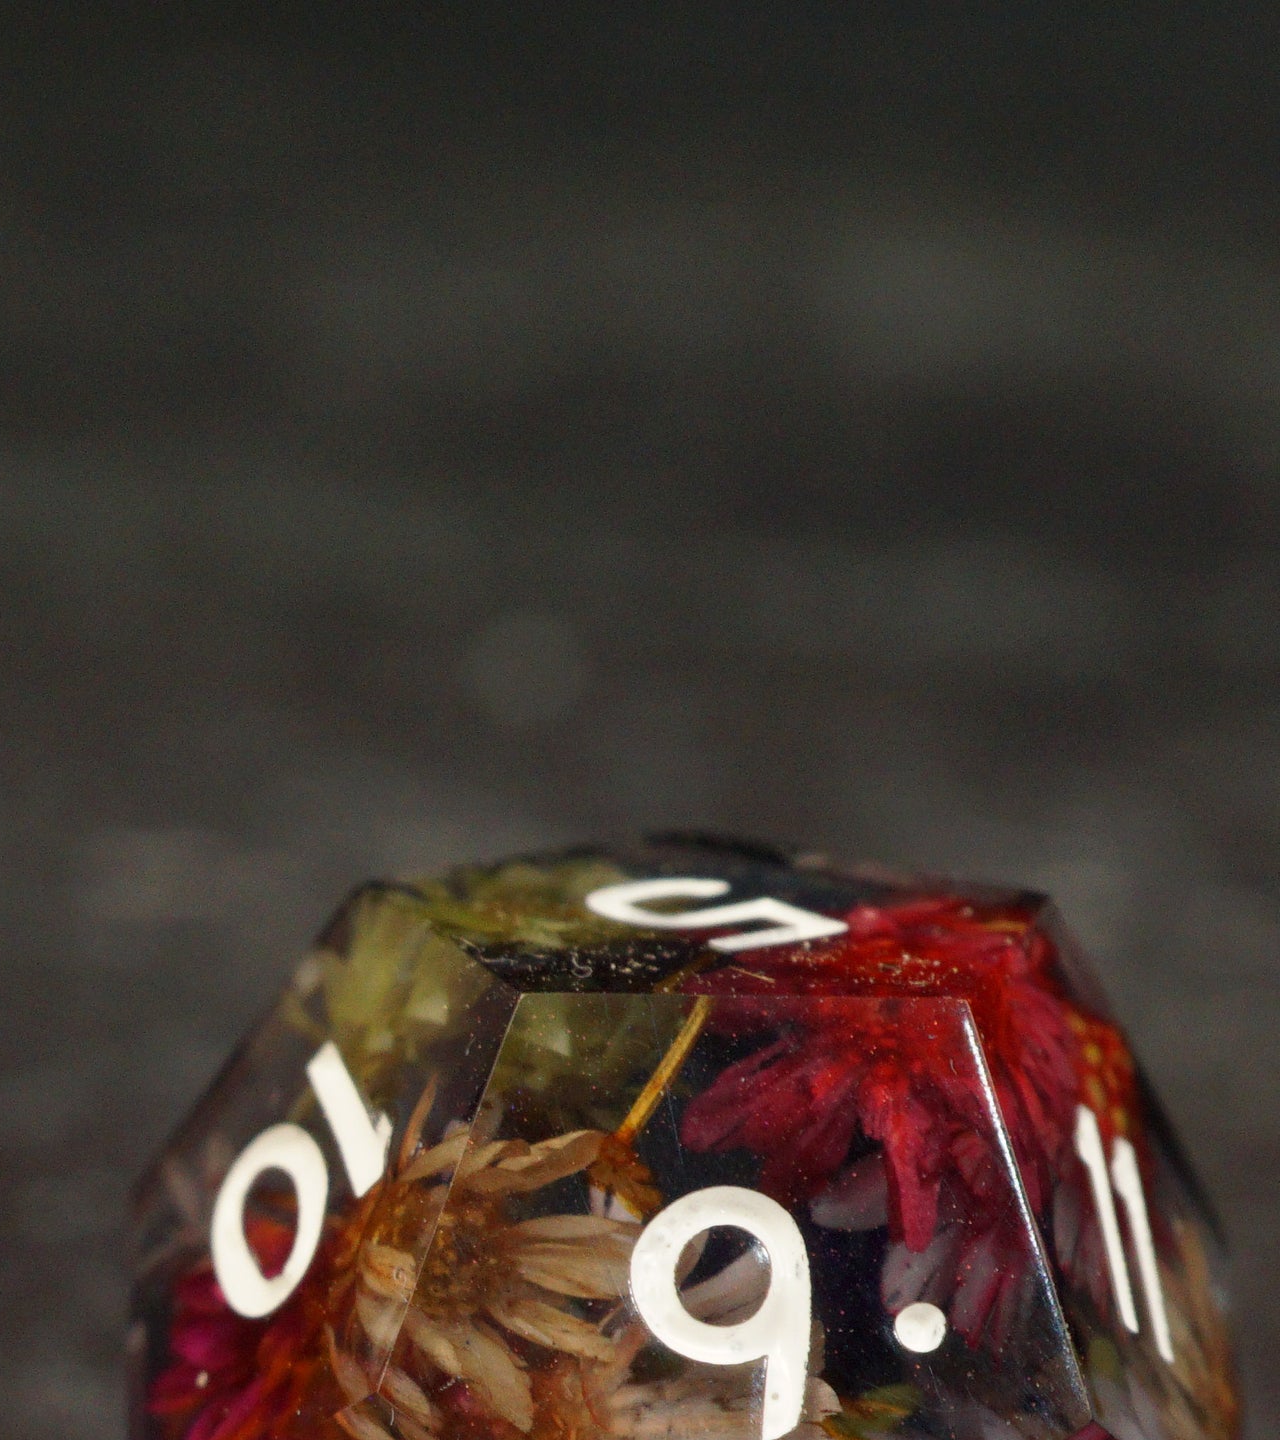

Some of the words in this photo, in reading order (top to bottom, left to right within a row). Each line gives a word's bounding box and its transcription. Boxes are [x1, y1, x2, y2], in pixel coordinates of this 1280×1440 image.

[584, 878, 847, 951] 5
[210, 1043, 393, 1318] 10
[1076, 1106, 1175, 1364] 11
